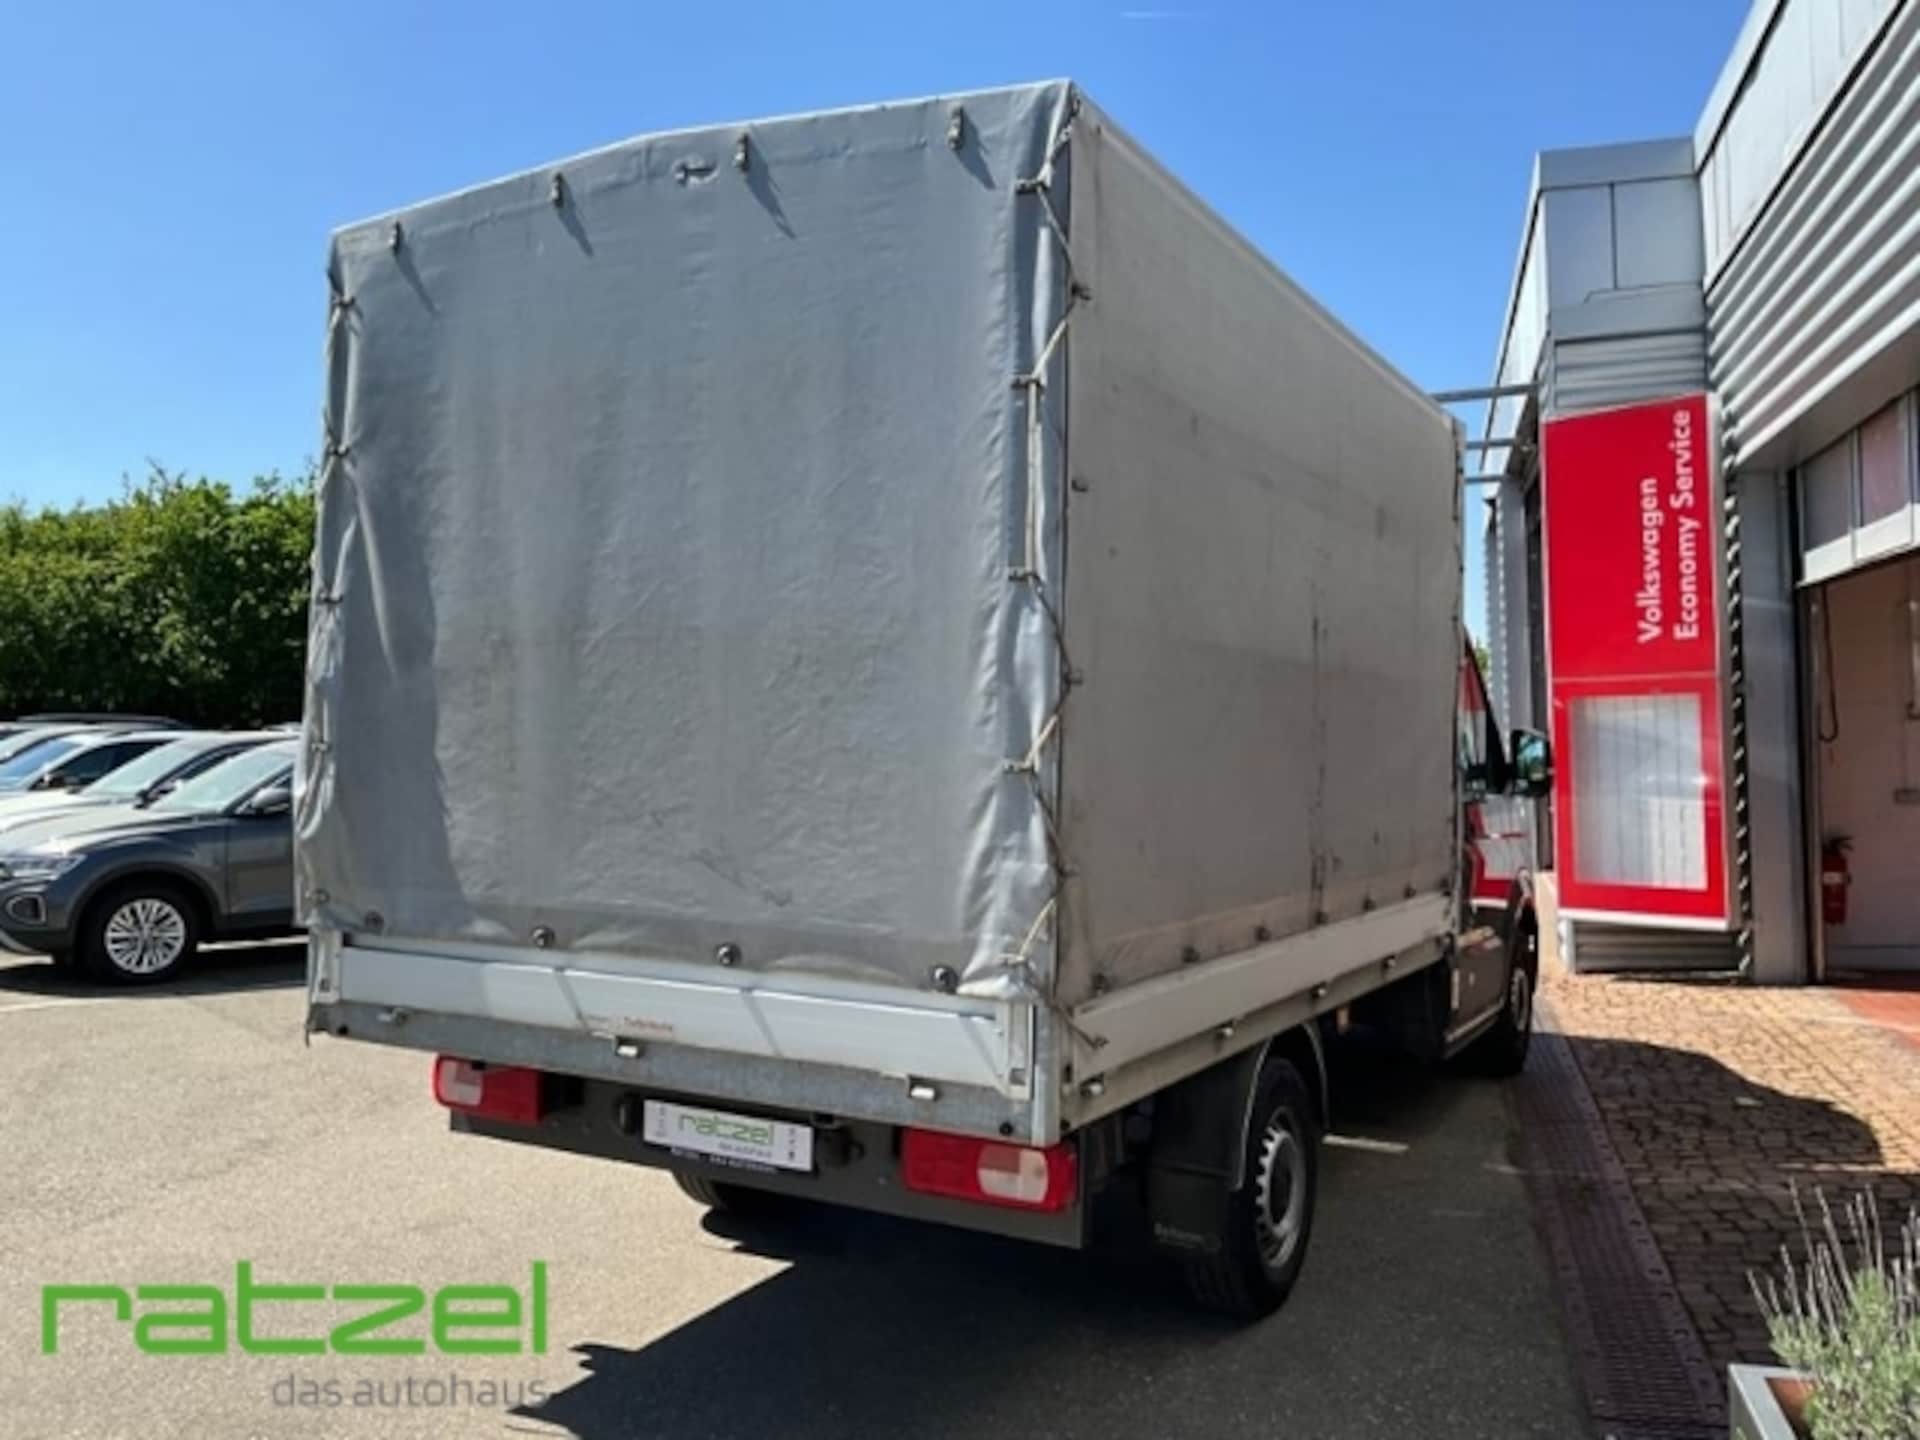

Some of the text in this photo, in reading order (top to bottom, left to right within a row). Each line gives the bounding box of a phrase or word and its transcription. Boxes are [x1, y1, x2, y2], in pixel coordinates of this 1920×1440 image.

[1636, 477, 1664, 643] Volkswagen
[1669, 410, 1701, 640] Economy Service
[678, 1115, 774, 1146] ratzel
